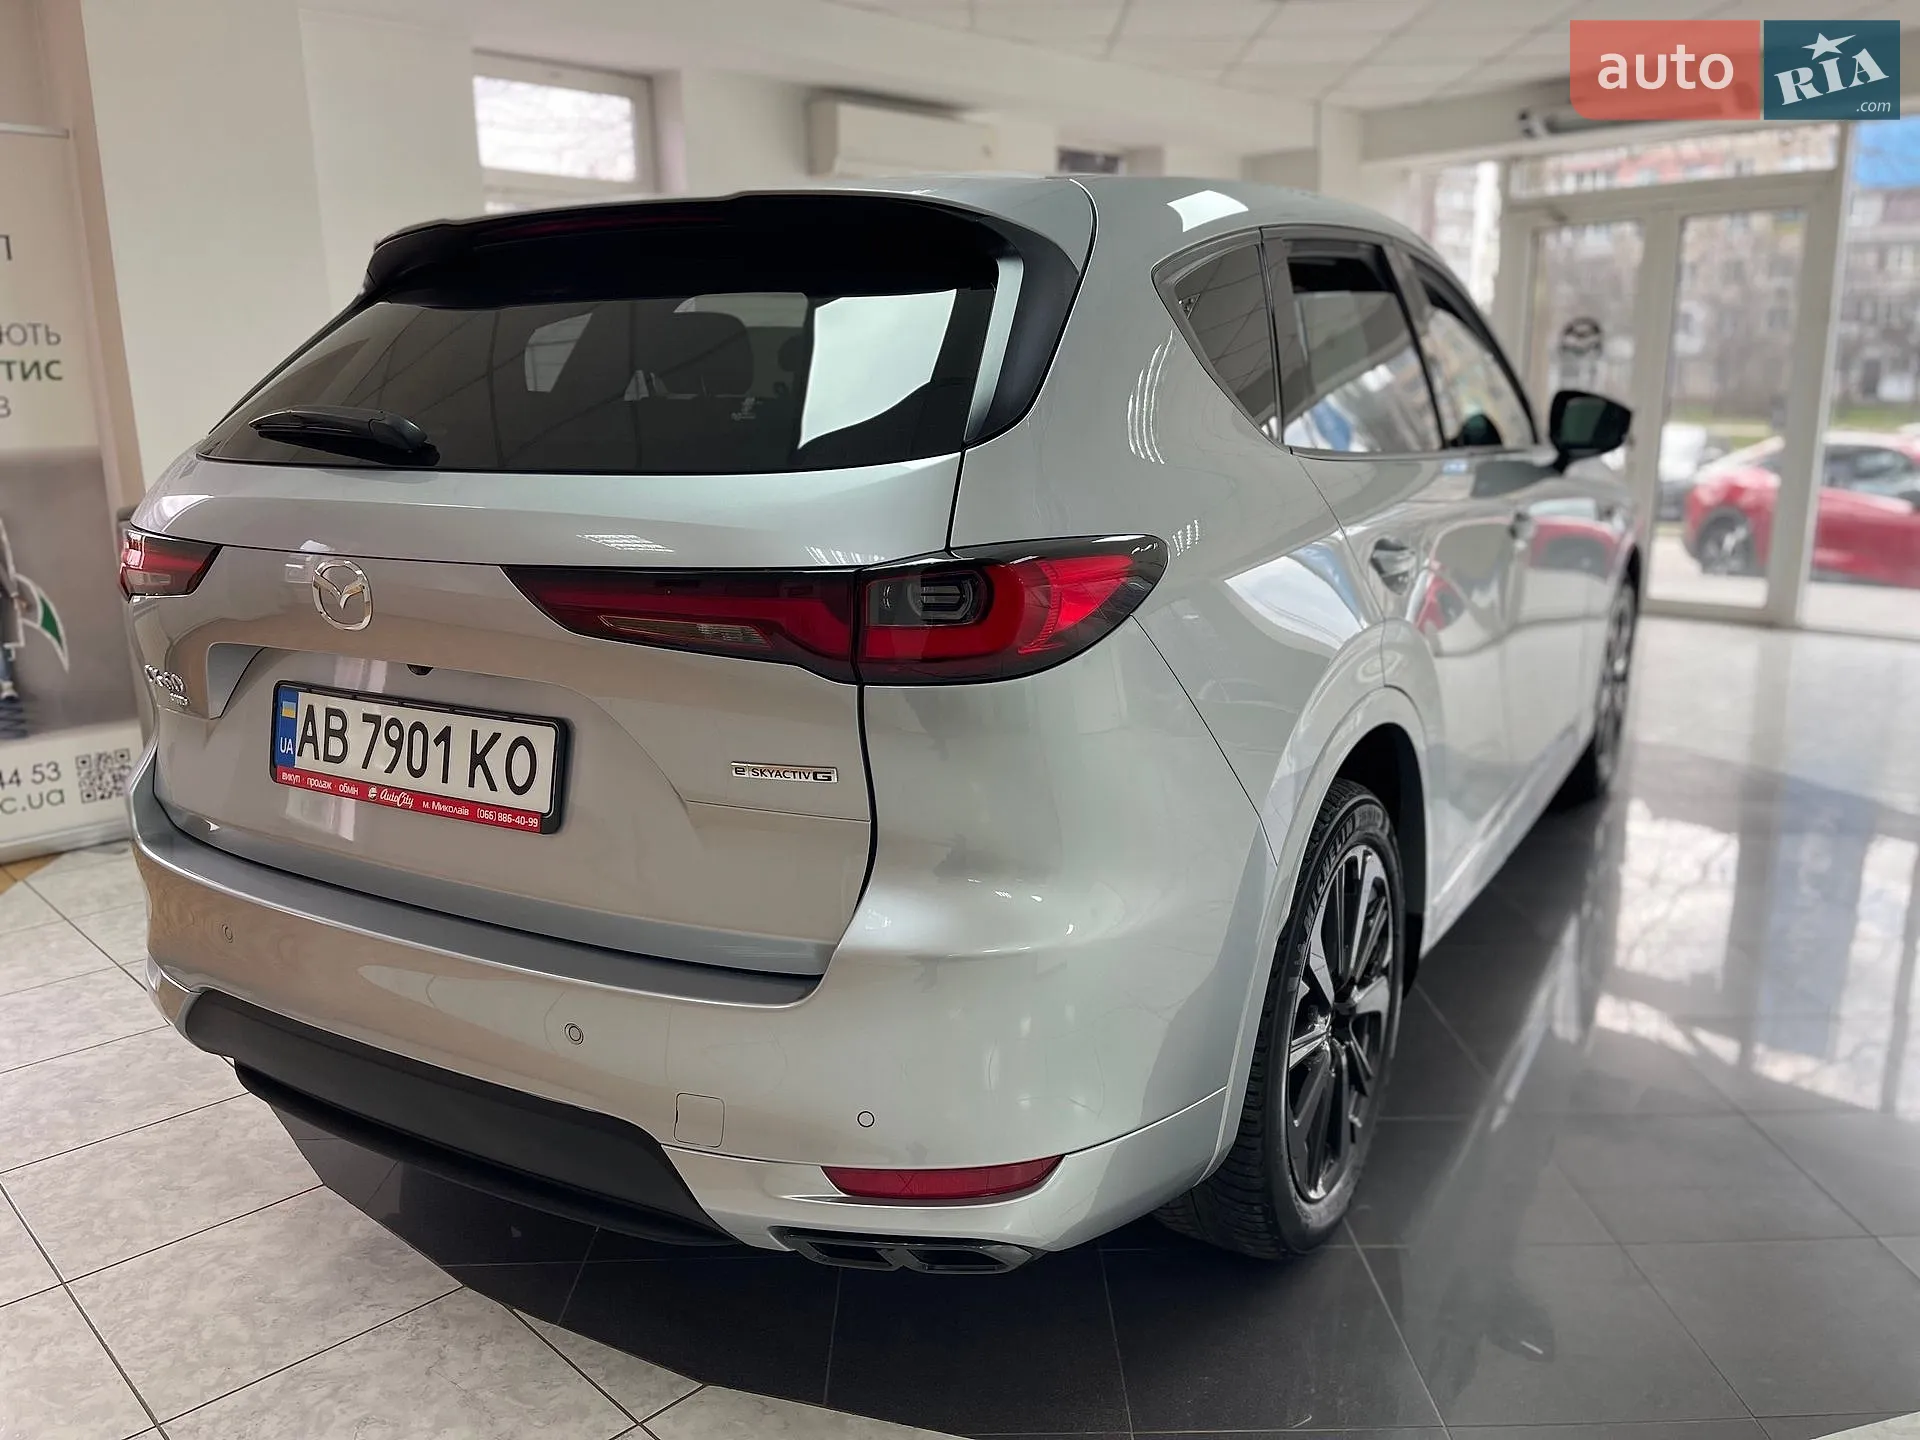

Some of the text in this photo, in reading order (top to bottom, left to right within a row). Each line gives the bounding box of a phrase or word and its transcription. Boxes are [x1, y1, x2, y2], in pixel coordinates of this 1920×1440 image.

[279, 736, 294, 755] UA
[296, 704, 537, 796] AB 7901 KO
[31, 761, 62, 785] 53
[281, 771, 301, 785] викуп
[306, 777, 333, 790] продаж
[338, 783, 359, 796] обмін
[379, 788, 415, 808] AutoCity
[431, 800, 470, 816] Миколаїв
